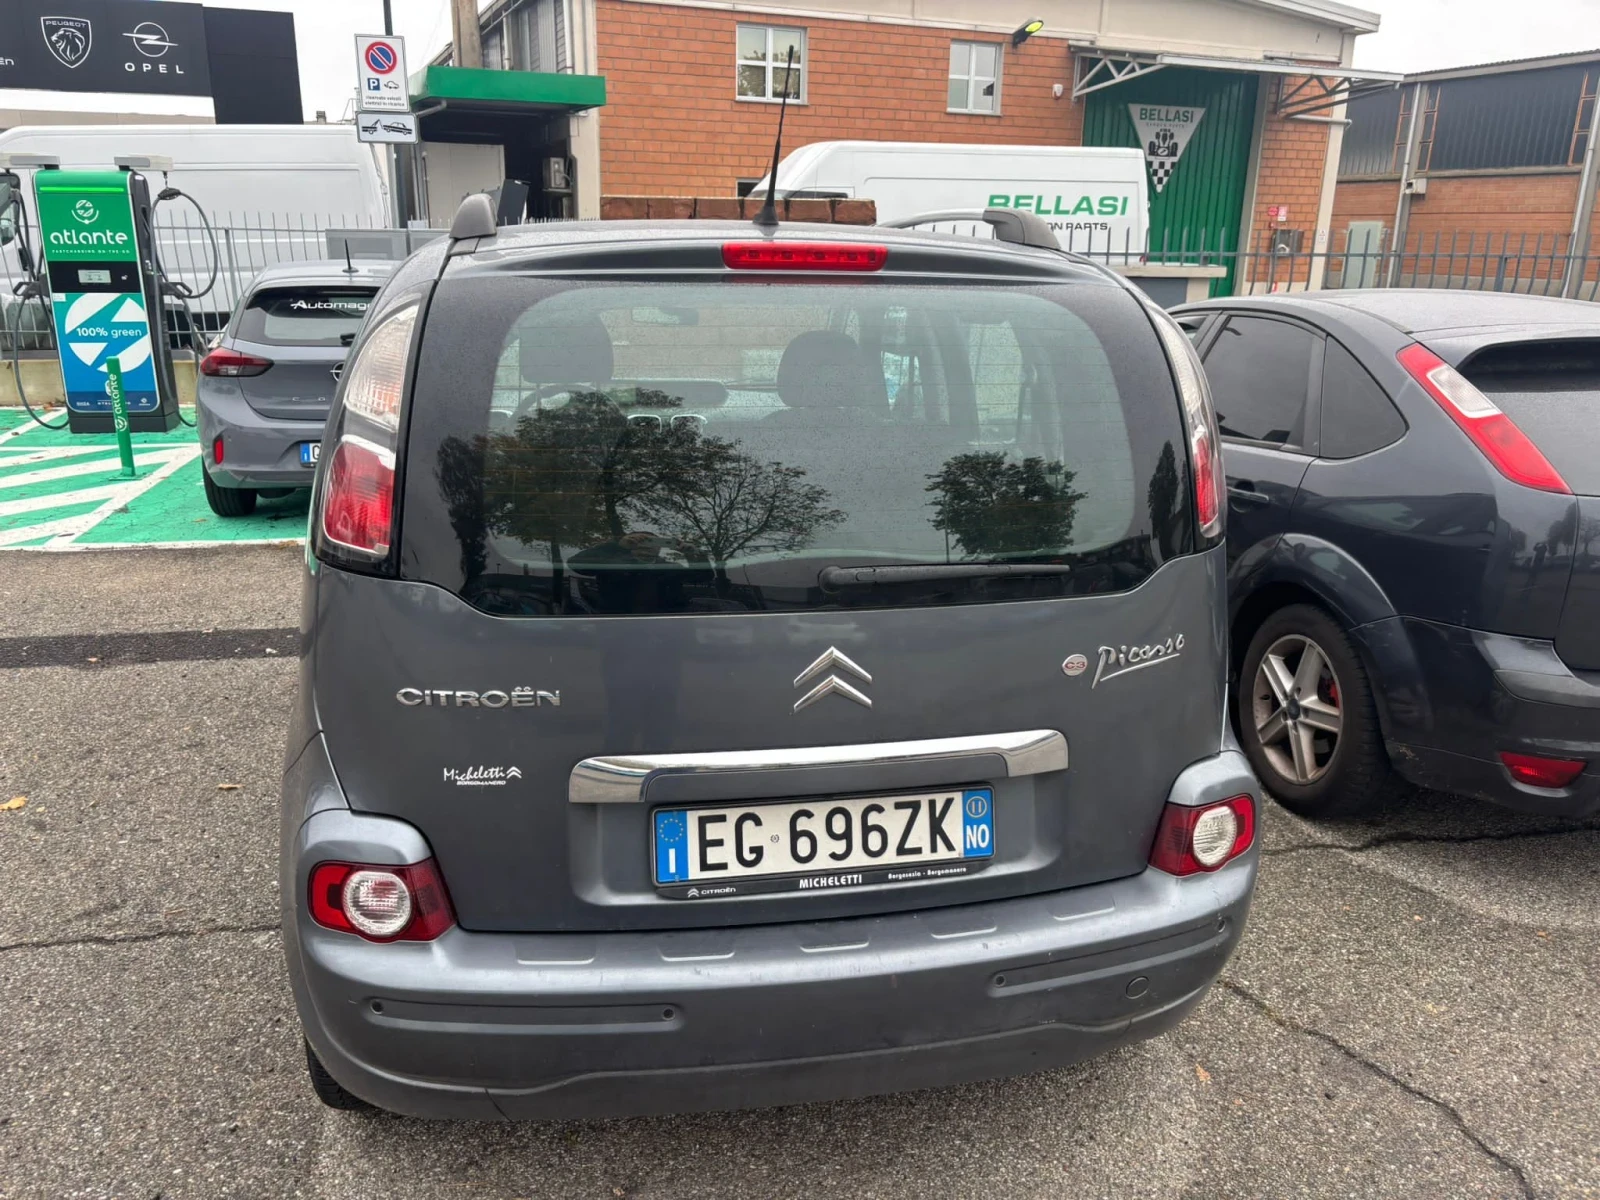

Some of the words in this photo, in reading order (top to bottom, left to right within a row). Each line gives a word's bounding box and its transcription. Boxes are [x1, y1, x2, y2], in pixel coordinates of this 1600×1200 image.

[45, 20, 87, 28] PEUGEOT
[124, 62, 185, 74] OPEL
[1139, 107, 1195, 123] BELLASI
[987, 194, 1129, 216] BELLASI
[1066, 222, 1108, 231] PARTS
[49, 229, 128, 245] atlante
[290, 299, 370, 311] Automag
[76, 327, 108, 337] 100%
[110, 328, 142, 339] green
[1064, 661, 1086, 669] C3
[1091, 633, 1185, 690] Picasso
[396, 686, 561, 708] CITROËN
[443, 765, 506, 781] Micheletti
[697, 812, 764, 872] EG
[789, 797, 956, 864] 696ZK
[966, 823, 990, 849] NO
[799, 874, 863, 889] MICHELETTI
